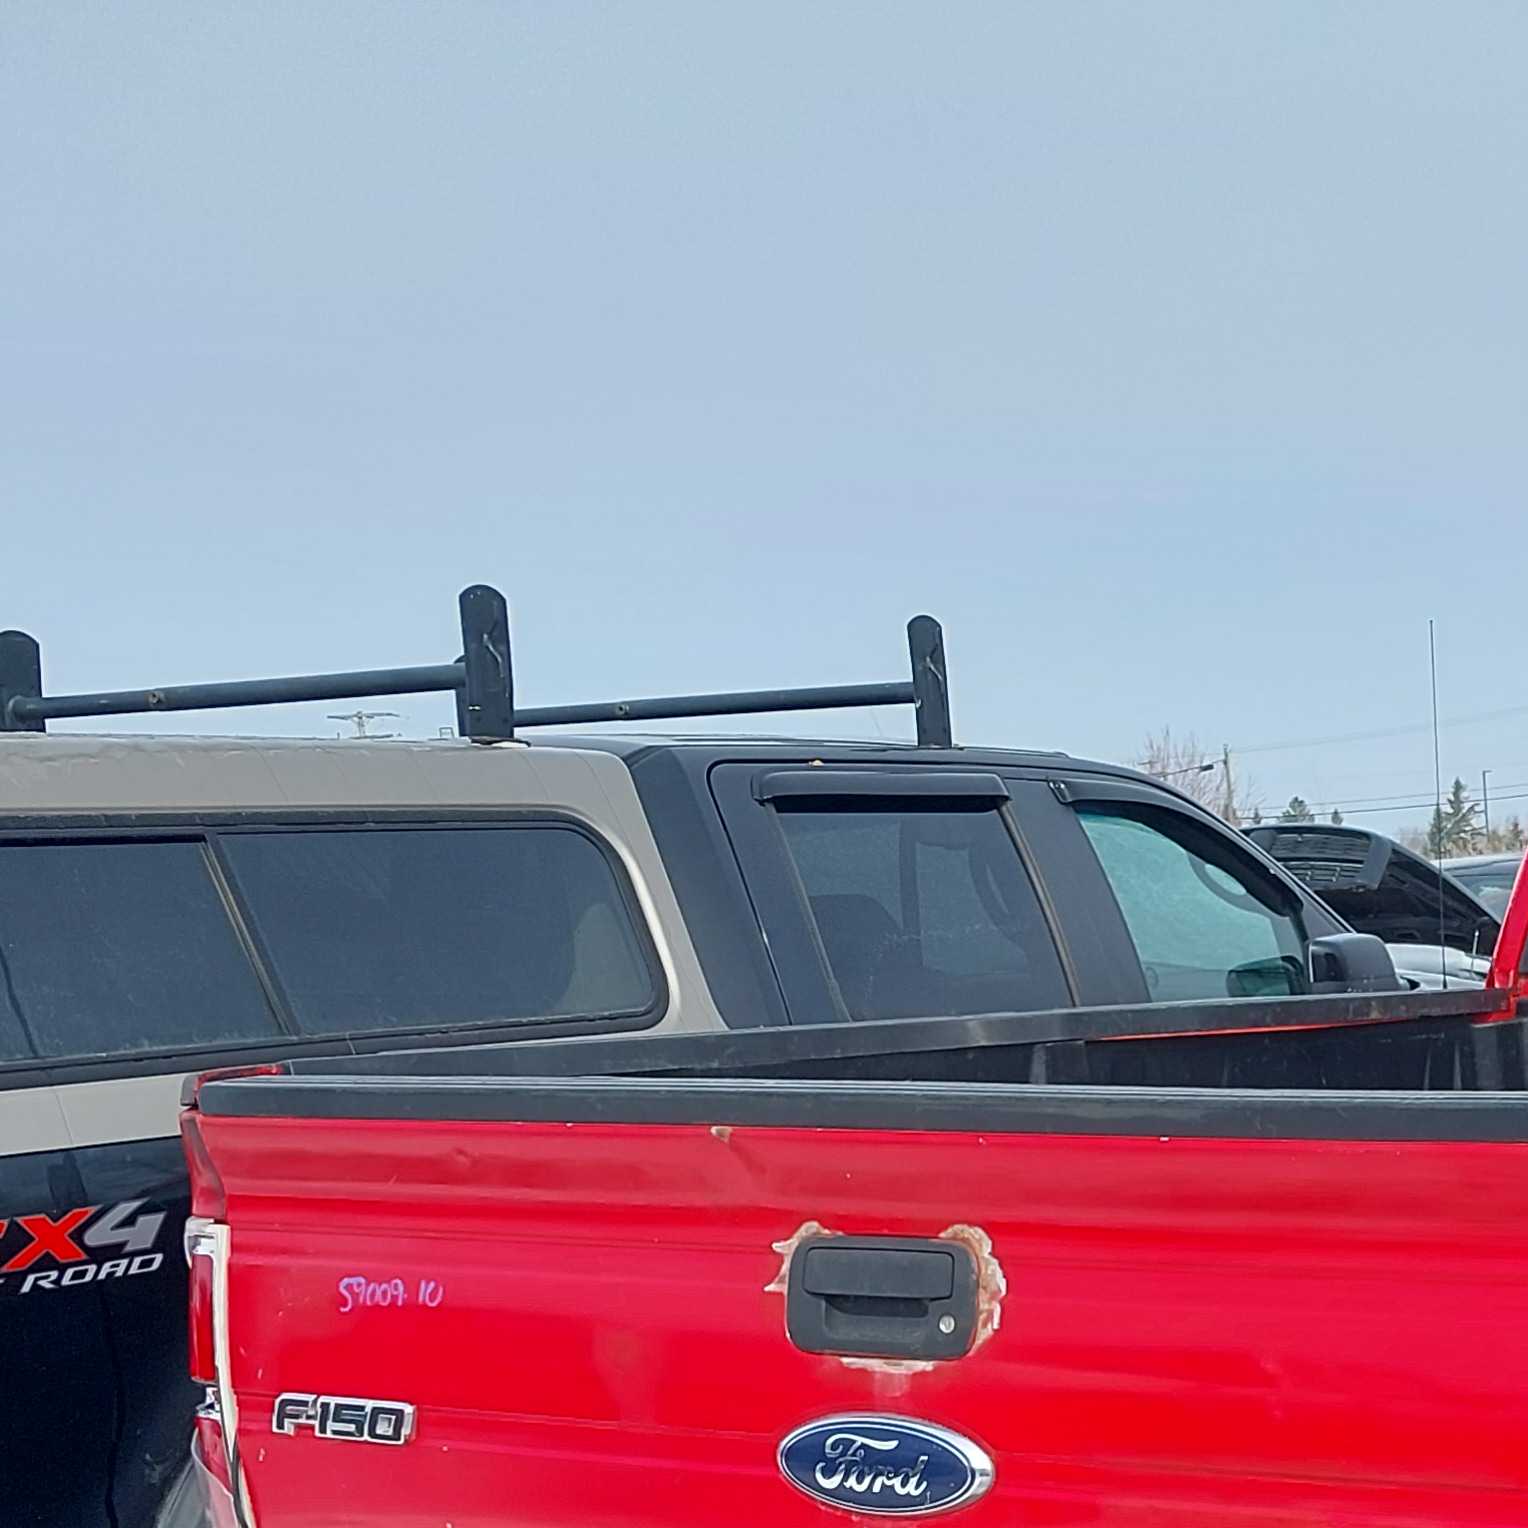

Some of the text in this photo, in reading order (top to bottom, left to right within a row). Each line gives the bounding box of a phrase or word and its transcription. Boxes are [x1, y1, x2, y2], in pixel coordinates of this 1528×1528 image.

[0, 1197, 167, 1273] X4
[18, 1252, 164, 1295] ROAD
[272, 1392, 417, 1446] F-150
[814, 1432, 930, 1497] Ford
